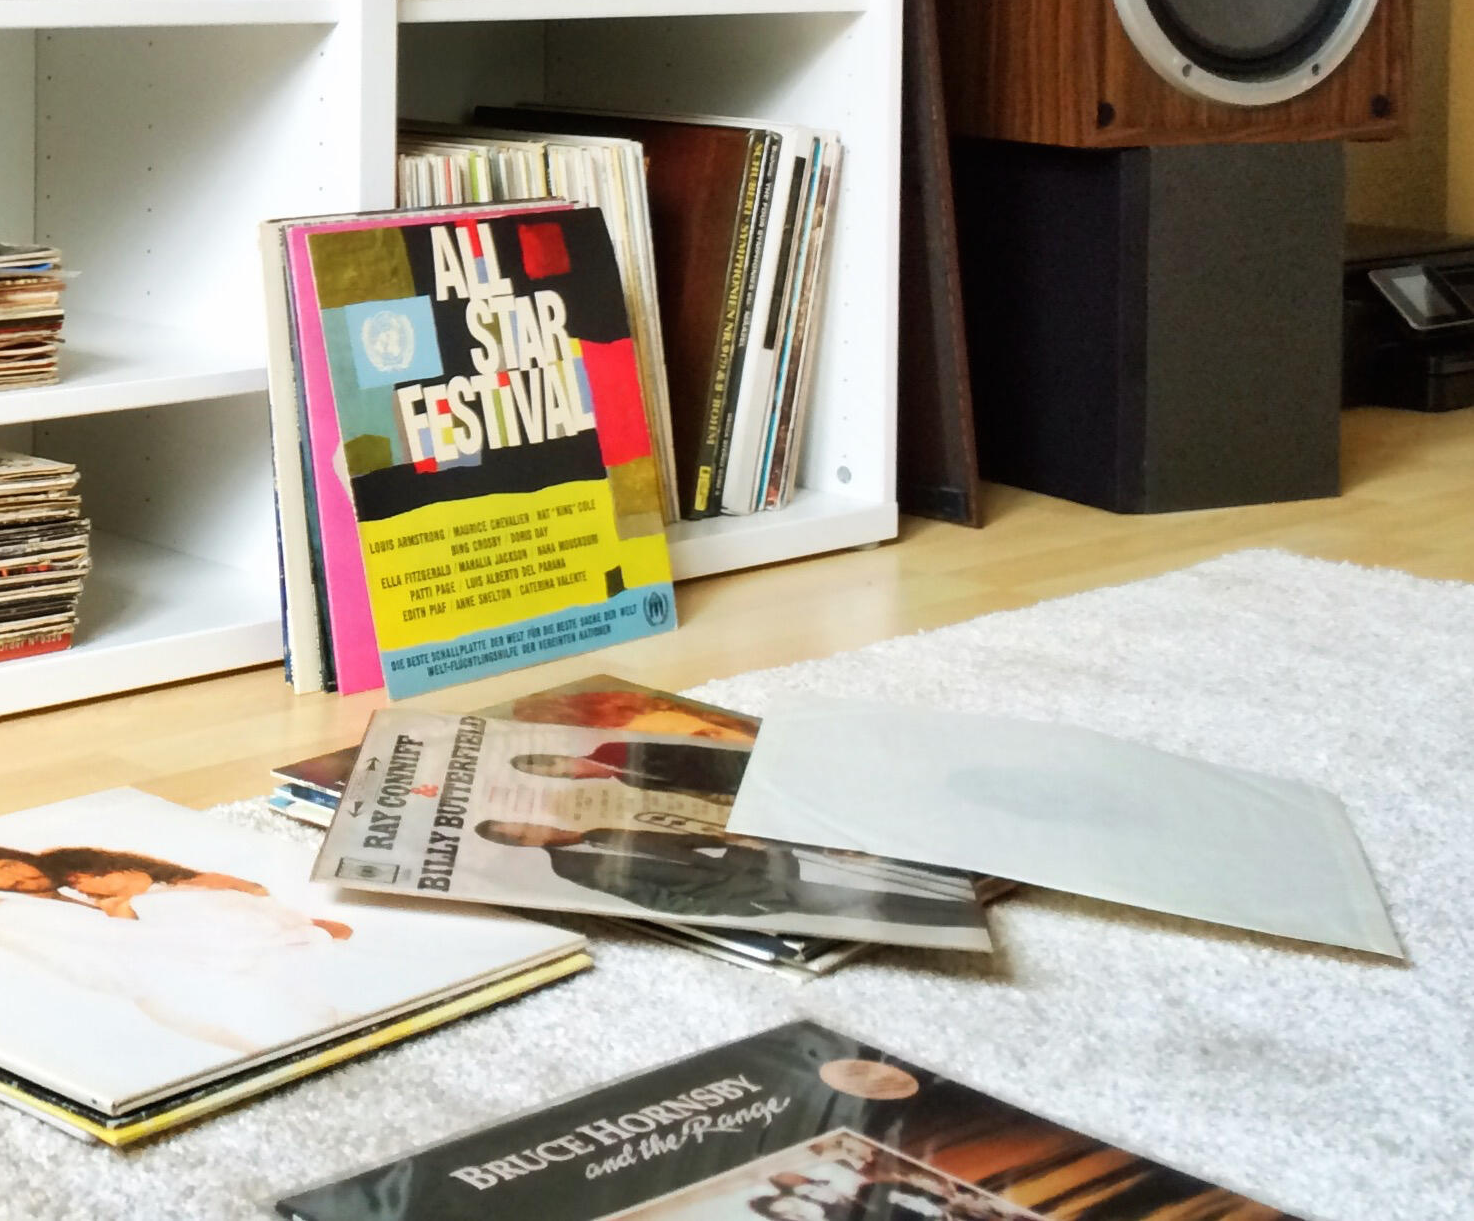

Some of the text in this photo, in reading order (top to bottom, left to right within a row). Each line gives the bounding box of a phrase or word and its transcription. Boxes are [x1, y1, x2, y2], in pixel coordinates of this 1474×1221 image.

[430, 222, 512, 302] ALL
[725, 224, 749, 319] SYMPHONIEN
[466, 289, 574, 375] STAR
[368, 539, 395, 554] LOUIS
[397, 529, 446, 552] ARMSTRONG
[453, 521, 487, 537] MAURICE
[490, 513, 530, 530] CHEVALIER
[577, 499, 596, 513] COLE
[451, 526, 548, 556] BING CROSBY DORIS DAY
[380, 575, 402, 589] ELLA
[404, 564, 452, 584] FITZGERALD
[458, 556, 493, 573] MAHALIA
[495, 549, 528, 565] JACKSON
[402, 571, 587, 622] EDITH PIAF ANNE SHELTON CATERINA VALENTE
[409, 586, 433, 602] PATTI
[435, 582, 456, 596] PAGE
[465, 576, 484, 589] LUIS
[486, 568, 519, 585] ALBERTO
[521, 565, 536, 578] DEL
[390, 659, 406, 672] DIE
[406, 653, 430, 668] BESTE
[431, 639, 487, 662] SCHALLPLATTE
[490, 636, 504, 648] DER
[506, 631, 524, 644] WELT
[556, 618, 577, 632] BESTE
[603, 609, 617, 622] DER
[620, 604, 638, 617] WELT
[363, 734, 424, 851] RAY CONNIFF
[417, 715, 487, 892] BILLY BUTTERFIELD
[449, 1073, 763, 1191] BRUCE HORNSBY
[584, 1096, 791, 1180] and the Range
